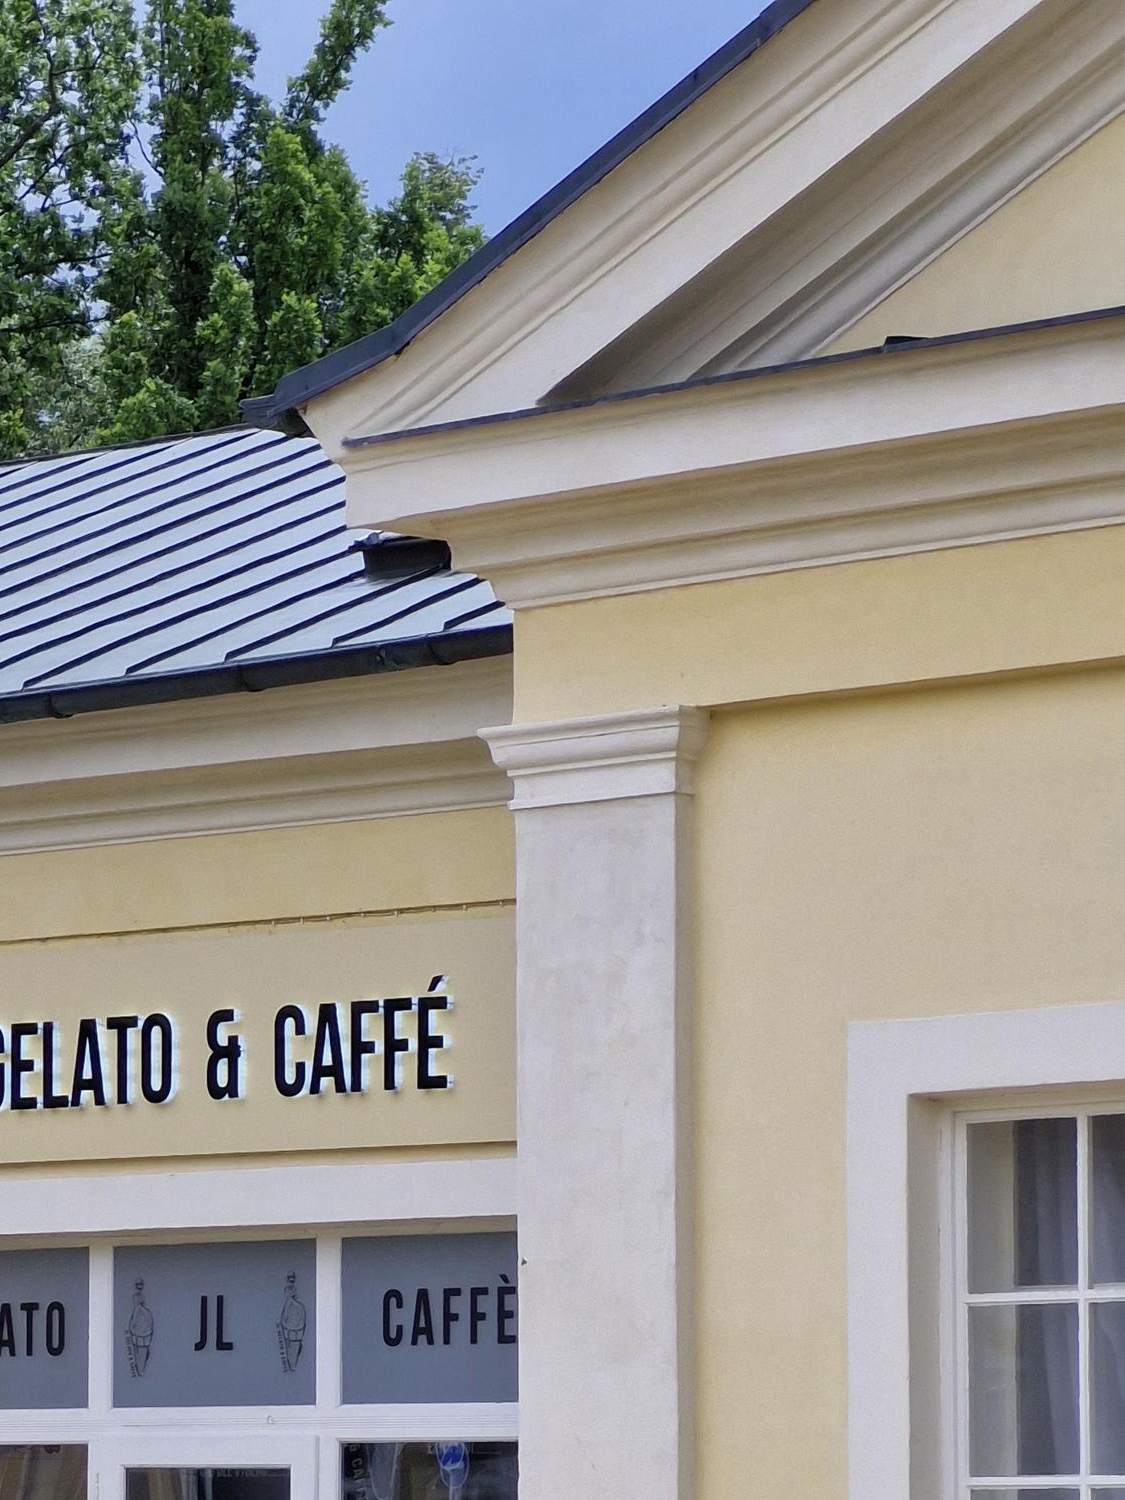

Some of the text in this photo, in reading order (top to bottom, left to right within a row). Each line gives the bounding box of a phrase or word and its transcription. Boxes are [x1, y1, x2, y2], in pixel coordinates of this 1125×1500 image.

[207, 1009, 241, 1099] &
[275, 975, 447, 1097] CAFFÉ
[195, 1295, 233, 1351] JL
